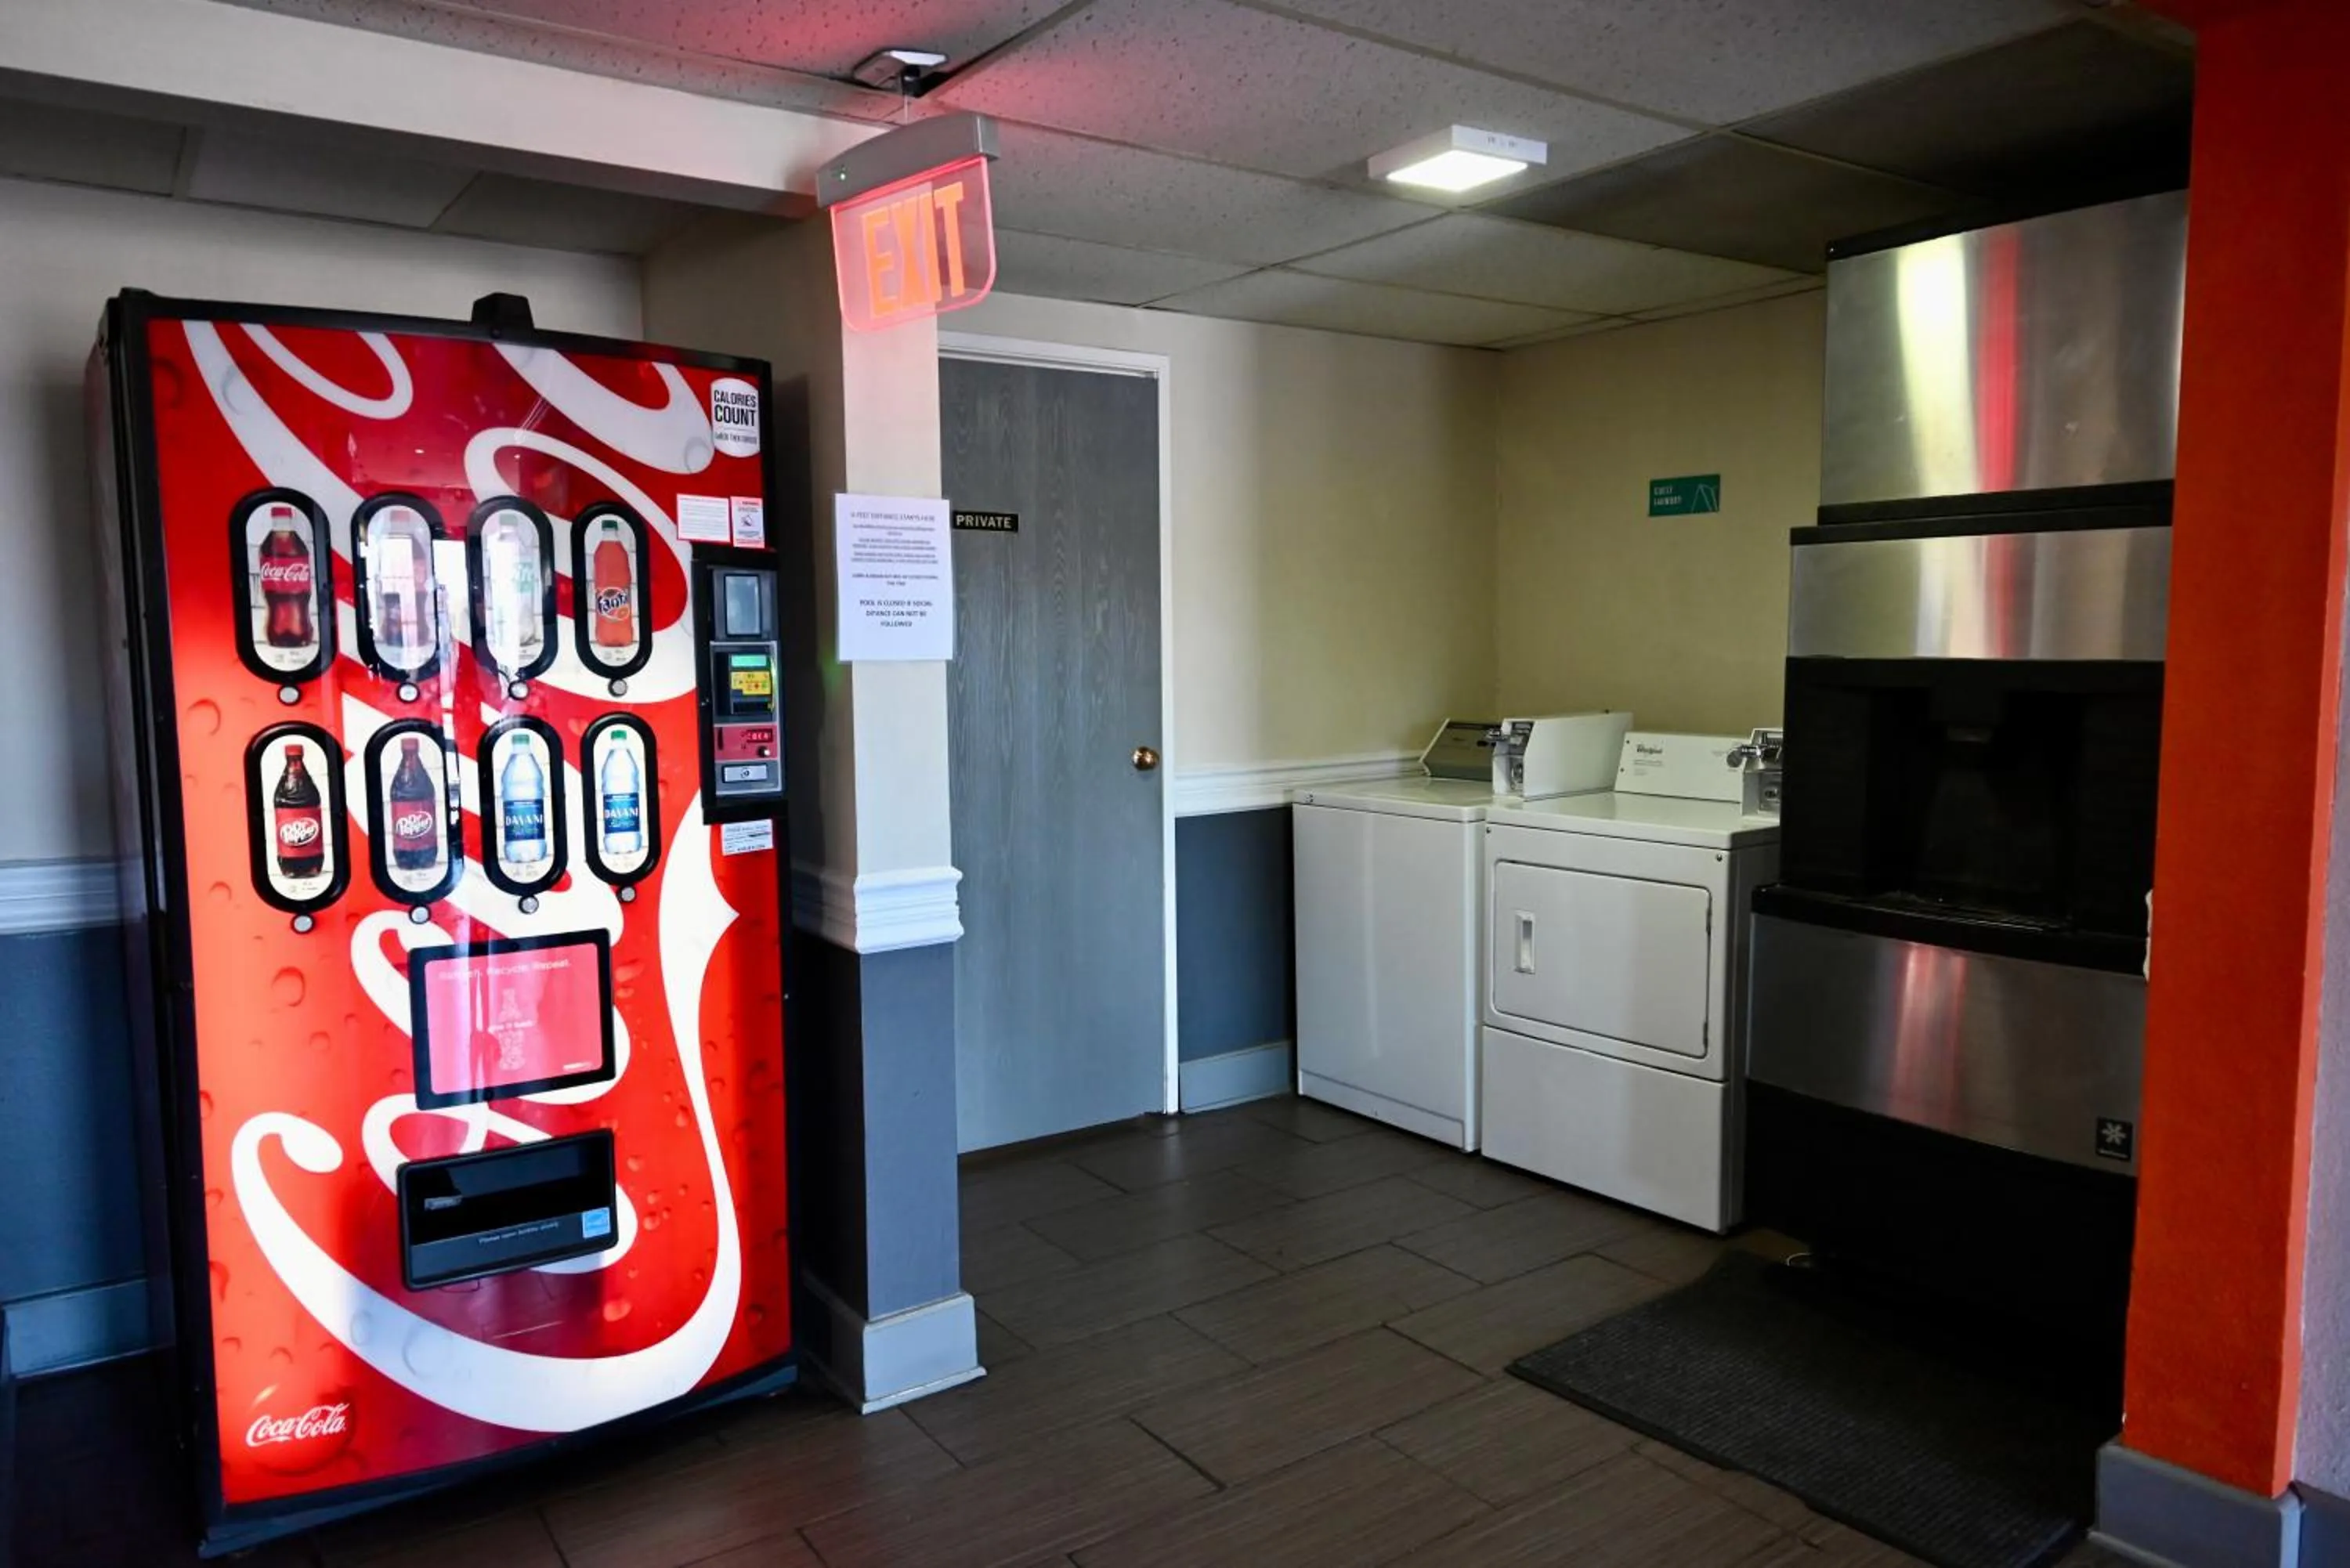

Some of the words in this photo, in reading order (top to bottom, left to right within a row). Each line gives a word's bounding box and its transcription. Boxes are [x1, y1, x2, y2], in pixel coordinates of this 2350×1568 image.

[862, 181, 965, 319] EXIT
[714, 388, 756, 407] CALORIES
[714, 404, 756, 427] COUNT
[956, 515, 1012, 529] PRIVATE
[261, 562, 310, 582] Coca-Cola
[246, 1403, 350, 1447] Coca-Cola
